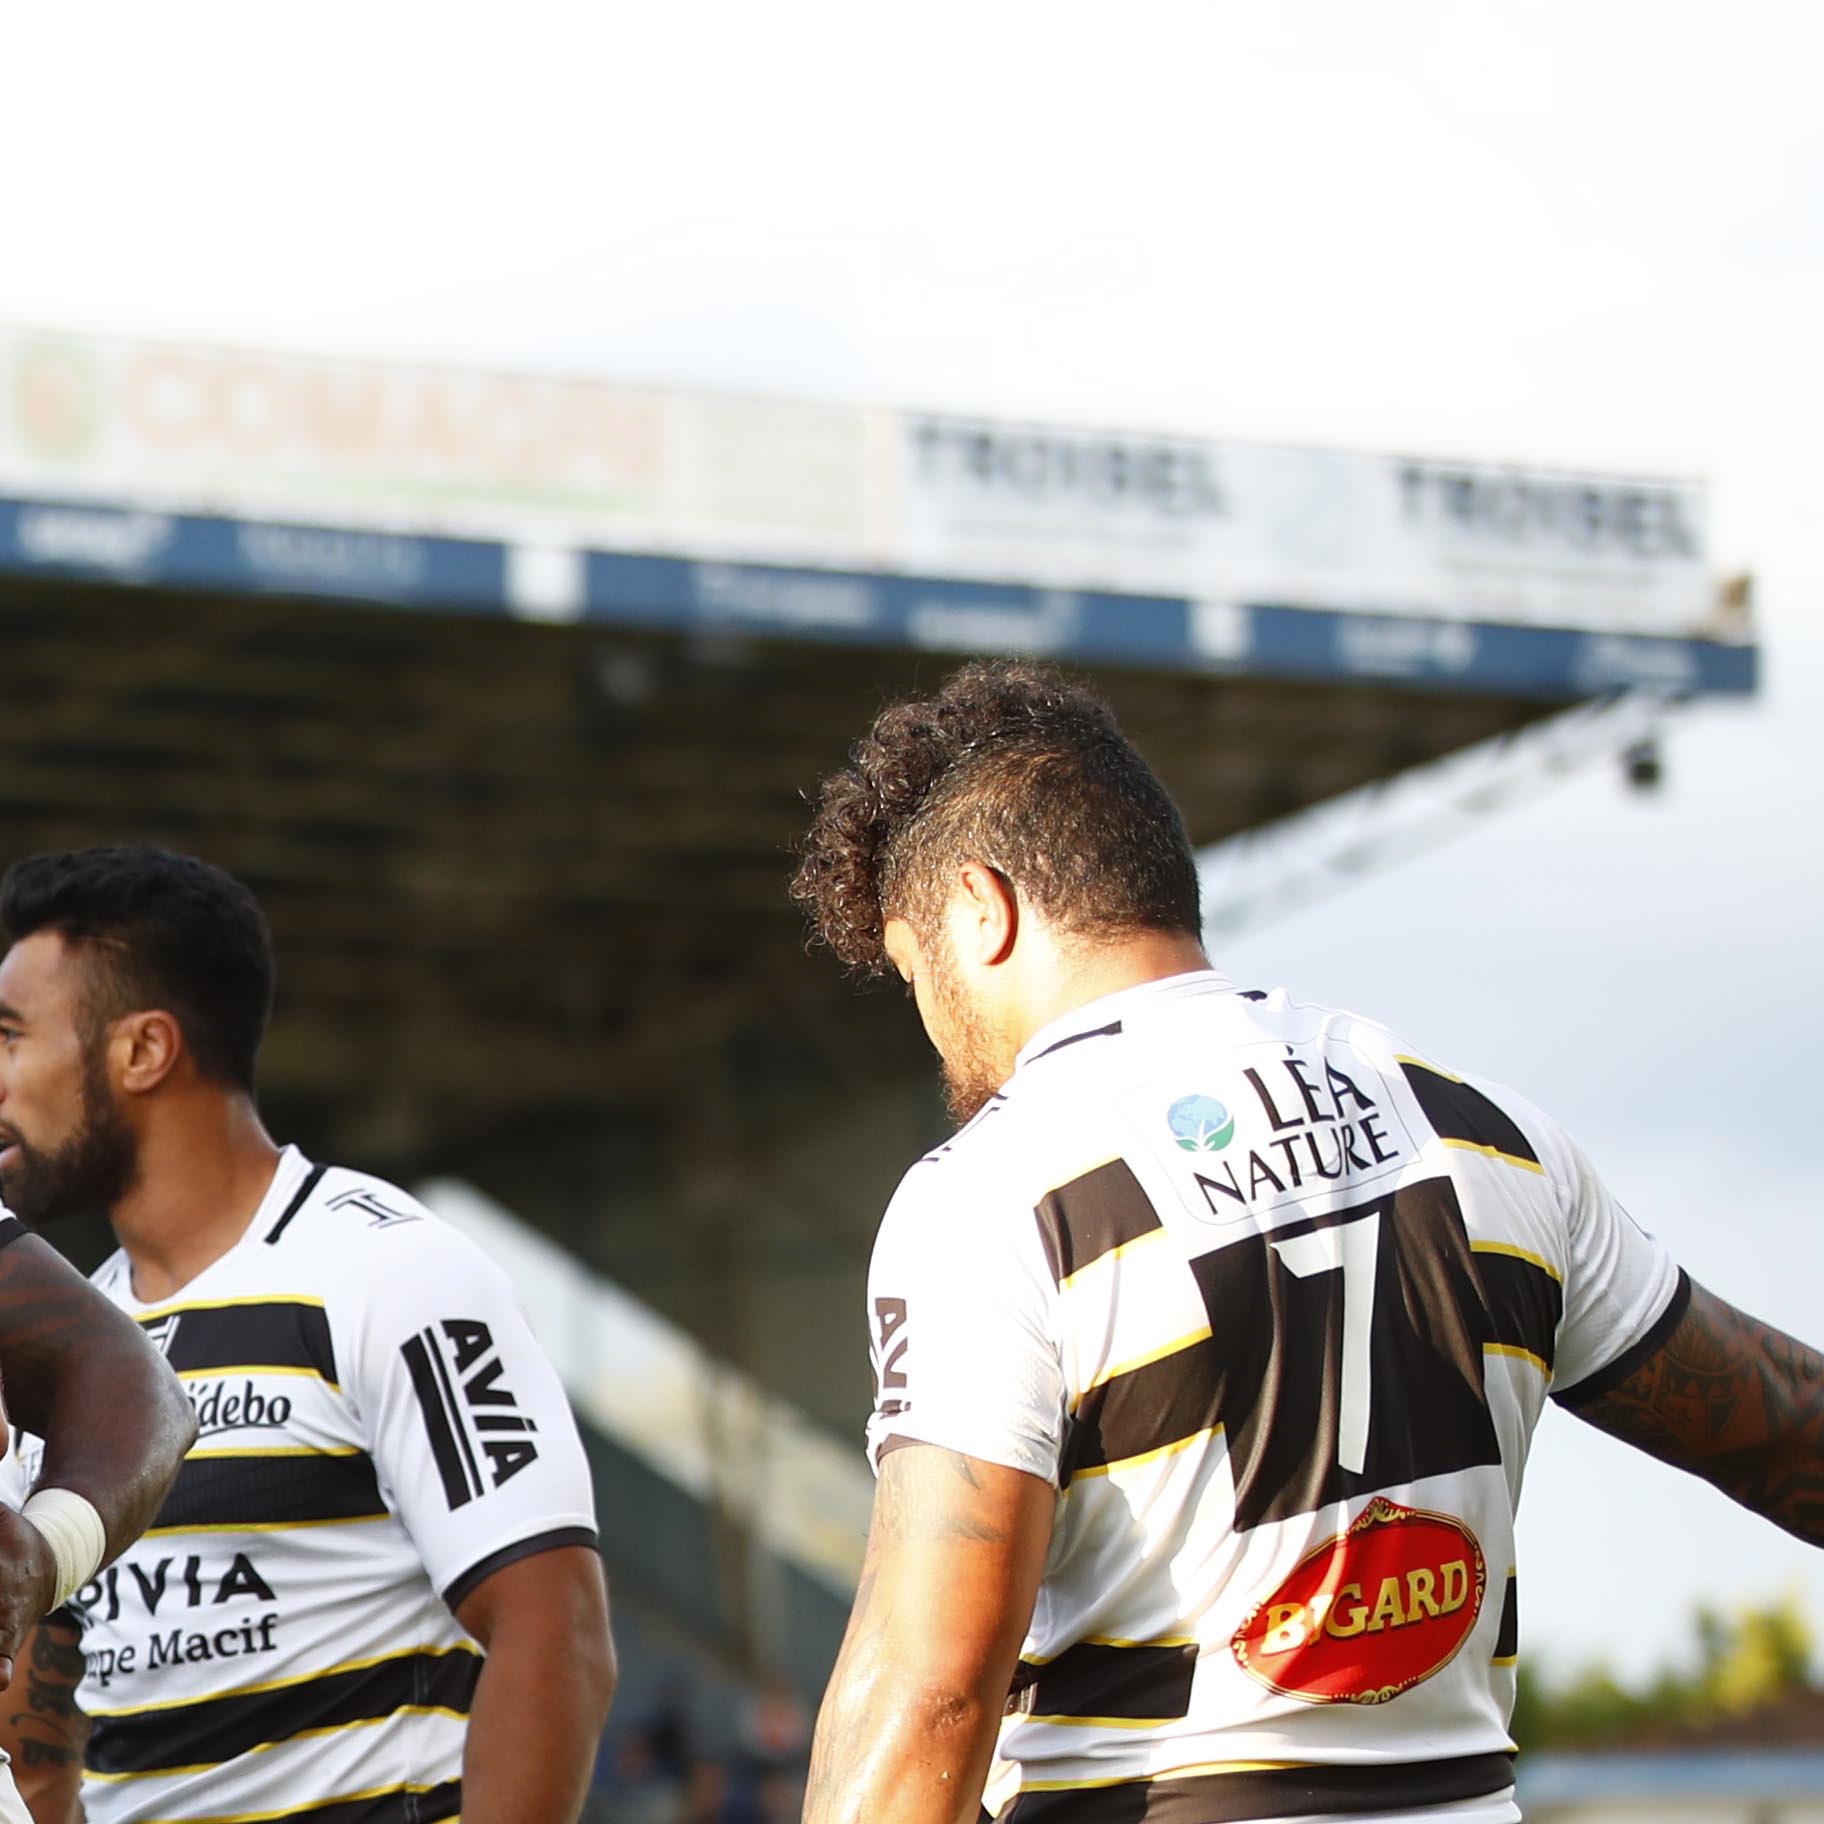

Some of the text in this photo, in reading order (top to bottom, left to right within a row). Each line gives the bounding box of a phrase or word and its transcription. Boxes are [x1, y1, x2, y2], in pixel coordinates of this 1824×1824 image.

[1243, 1044, 1376, 1132] LÉA
[1193, 1113, 1400, 1215] NATURE
[1269, 1210, 1381, 1476] 7
[192, 1380, 292, 1431] debo
[147, 1612, 279, 1670] Macif
[1260, 1559, 1469, 1655] BIGARD
